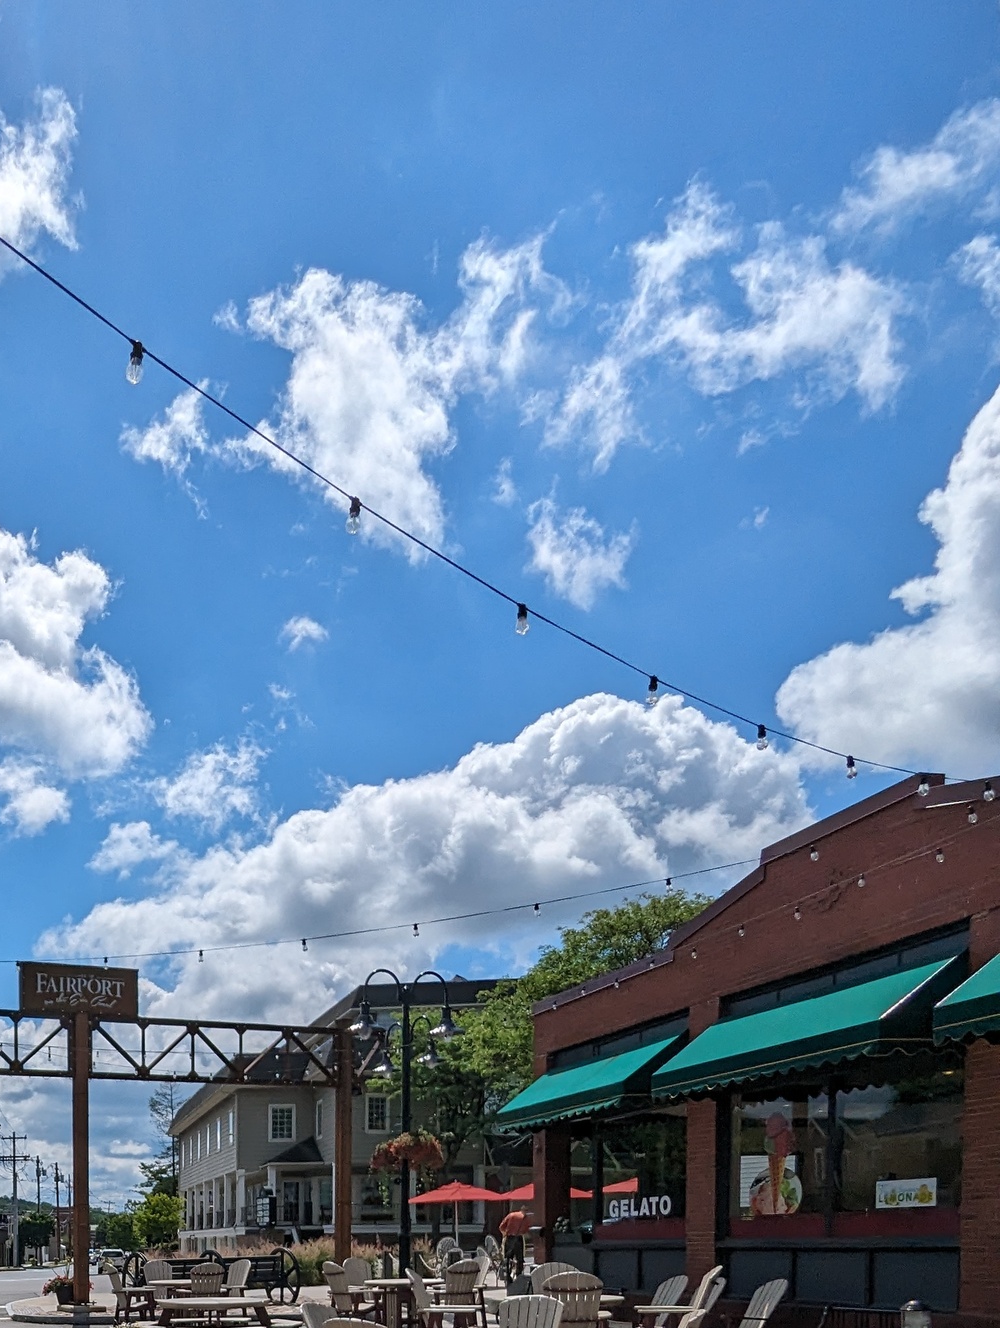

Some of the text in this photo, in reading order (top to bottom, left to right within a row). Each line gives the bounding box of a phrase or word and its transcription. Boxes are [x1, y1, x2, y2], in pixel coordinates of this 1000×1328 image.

[36, 972, 125, 998] FAIRPORT
[90, 996, 117, 1008] Canal
[878, 1191, 933, 1203] LMONADE
[609, 1195, 671, 1217] GELATO
